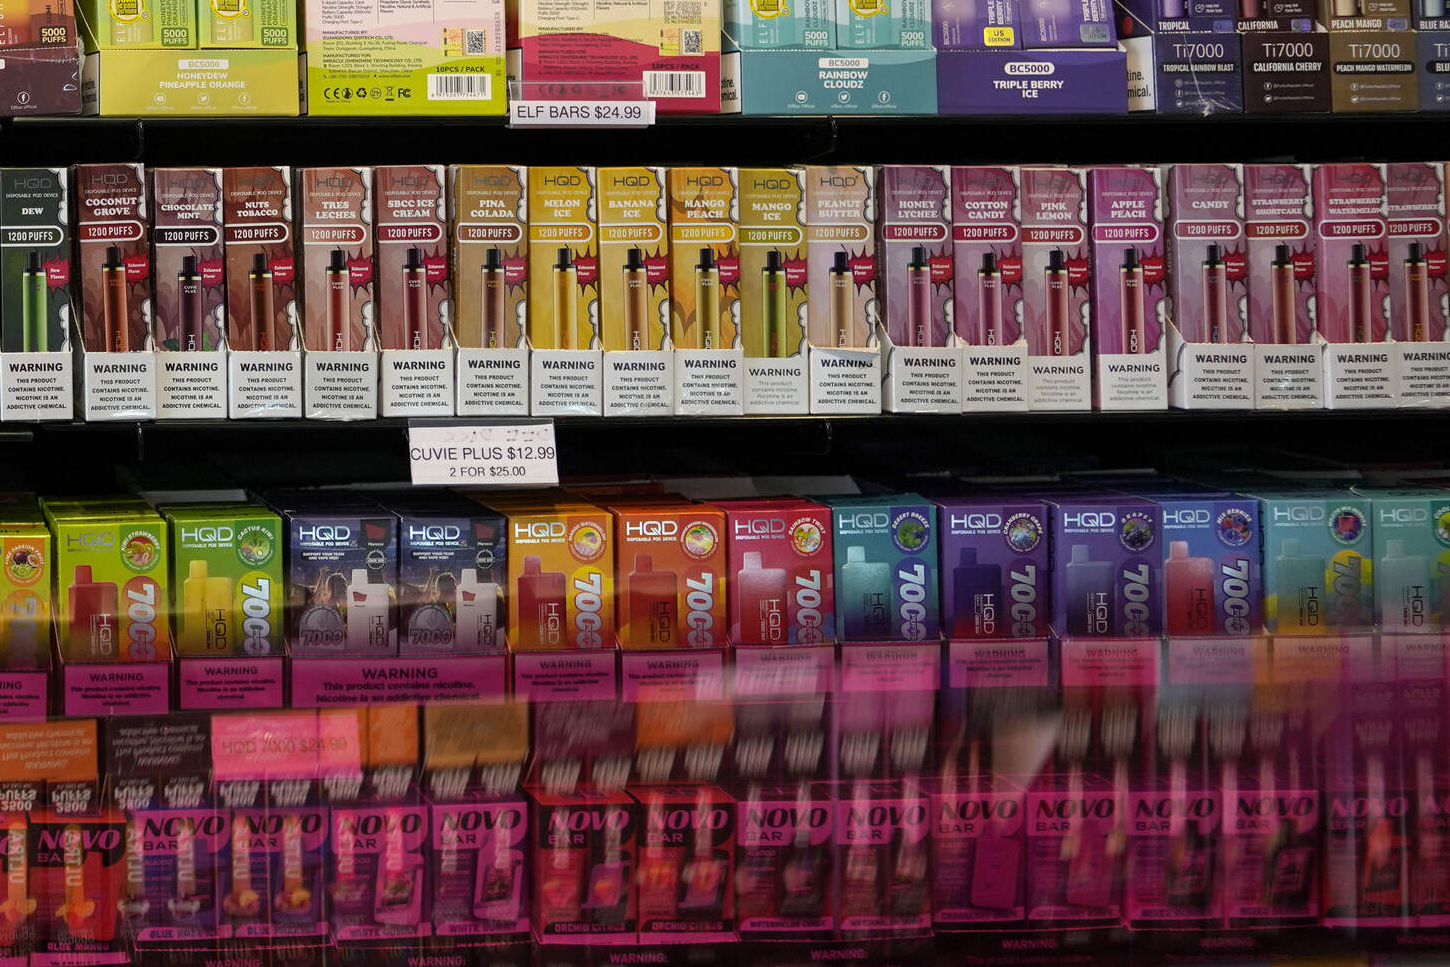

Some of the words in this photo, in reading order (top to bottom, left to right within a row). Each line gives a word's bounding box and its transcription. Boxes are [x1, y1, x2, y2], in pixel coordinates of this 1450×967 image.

[1174, 44, 1224, 58] Ti7000
[1010, 64, 1050, 73] BC5000
[1254, 63, 1293, 72] CALIFORNIA
[1295, 62, 1321, 71] CHERRY
[177, 72, 228, 80] HONEYDEW
[819, 71, 868, 80] RAINBOW
[159, 81, 206, 89] PINEAPPLE
[210, 81, 246, 89] ORANGE
[824, 80, 864, 89] CLOUDZ
[993, 81, 1027, 89] TRIPLE
[1030, 80, 1063, 89] BERRY
[1022, 90, 1038, 98] ICE
[517, 106, 542, 119] ELF
[549, 106, 591, 119] BARS
[595, 105, 641, 120] $24.99
[85, 197, 137, 207] COCONUT
[544, 199, 580, 208] MELON
[22, 207, 43, 216] DEW
[94, 206, 131, 216] GROVE
[554, 209, 571, 217] ICE
[538, 227, 557, 239] 1200
[559, 227, 583, 238] PUFFS
[1196, 354, 1247, 364] WARNING
[411, 448, 457, 460] CUVIE
[463, 448, 502, 459] PLUS
[508, 447, 555, 459] $12.99
[450, 468, 456, 477] 2
[461, 467, 485, 476] FOR
[490, 467, 525, 476] $25.00
[1064, 512, 1115, 529] HQD
[300, 526, 350, 541] HQD
[362, 667, 438, 679] WARNING
[940, 799, 1018, 821] NOVO
[746, 807, 828, 828] NOVO
[938, 823, 974, 833] BAR
